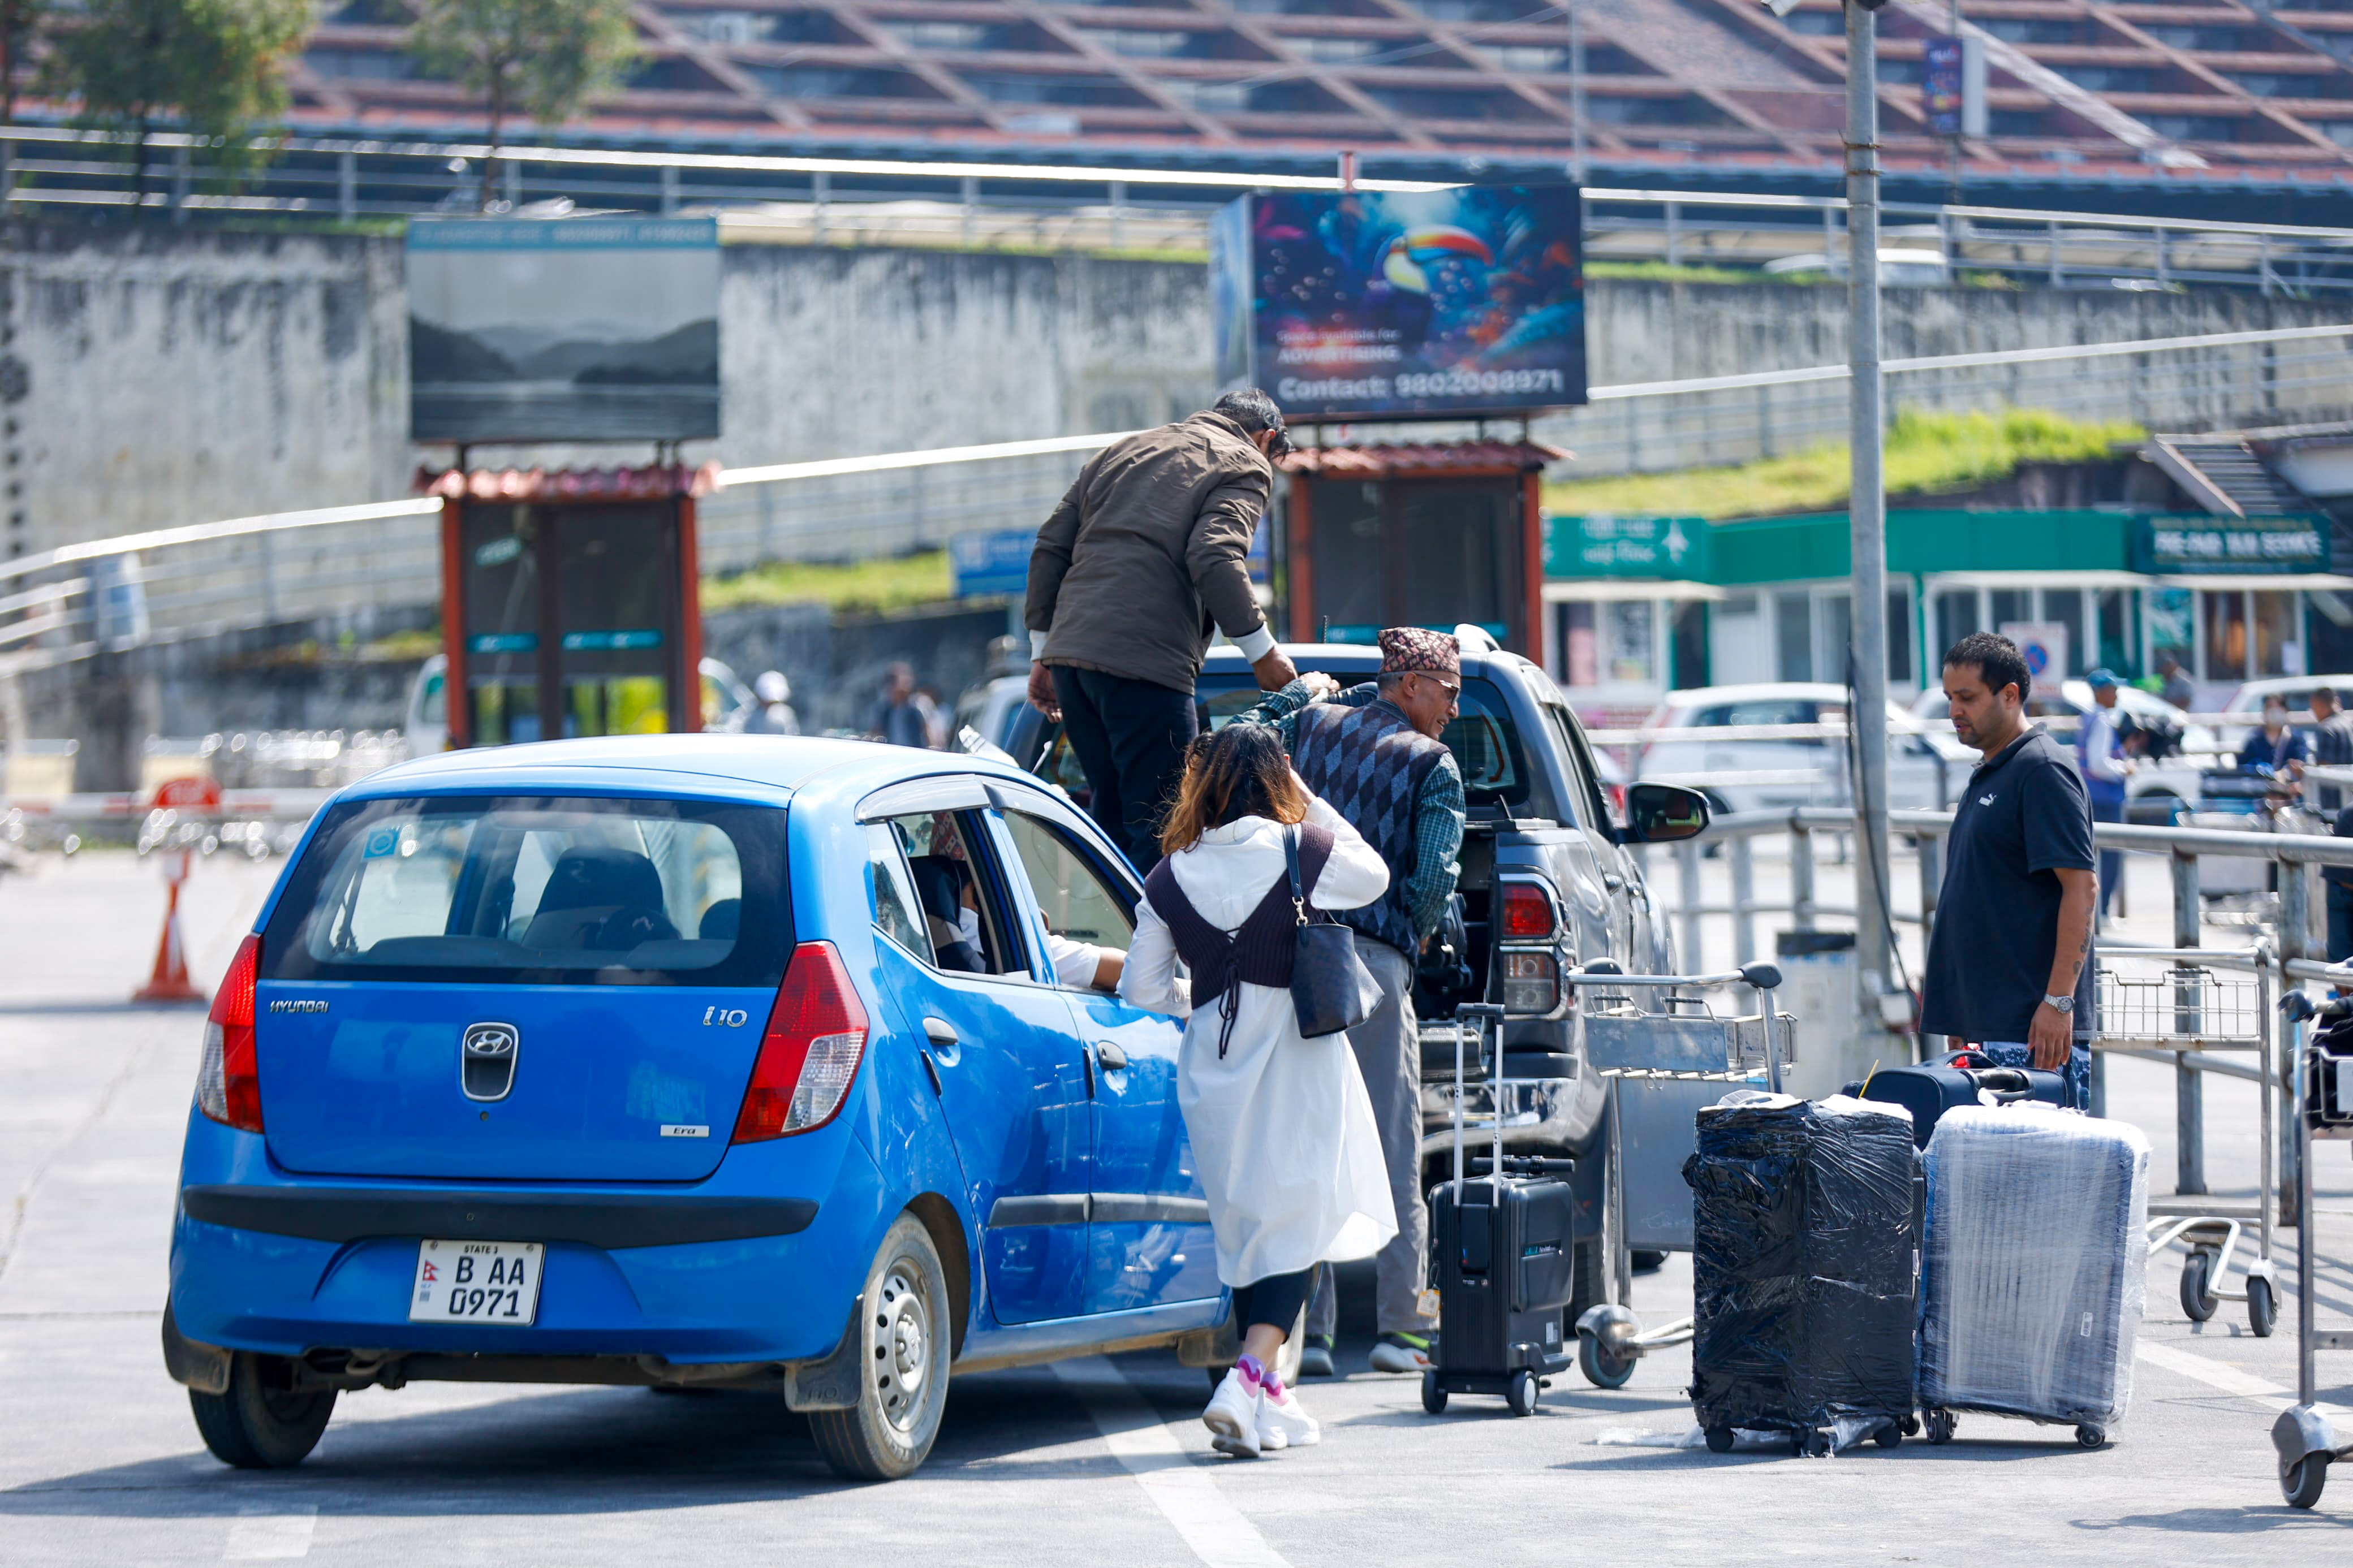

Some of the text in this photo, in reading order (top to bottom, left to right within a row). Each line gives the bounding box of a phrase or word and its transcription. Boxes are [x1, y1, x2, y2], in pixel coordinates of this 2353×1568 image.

[1278, 369, 1565, 401] Contact: 9802008971
[270, 1000, 329, 1013] HYUNDAI
[464, 1245, 490, 1254] STATE
[455, 1256, 524, 1285] B AA
[449, 1288, 519, 1317] 0971
